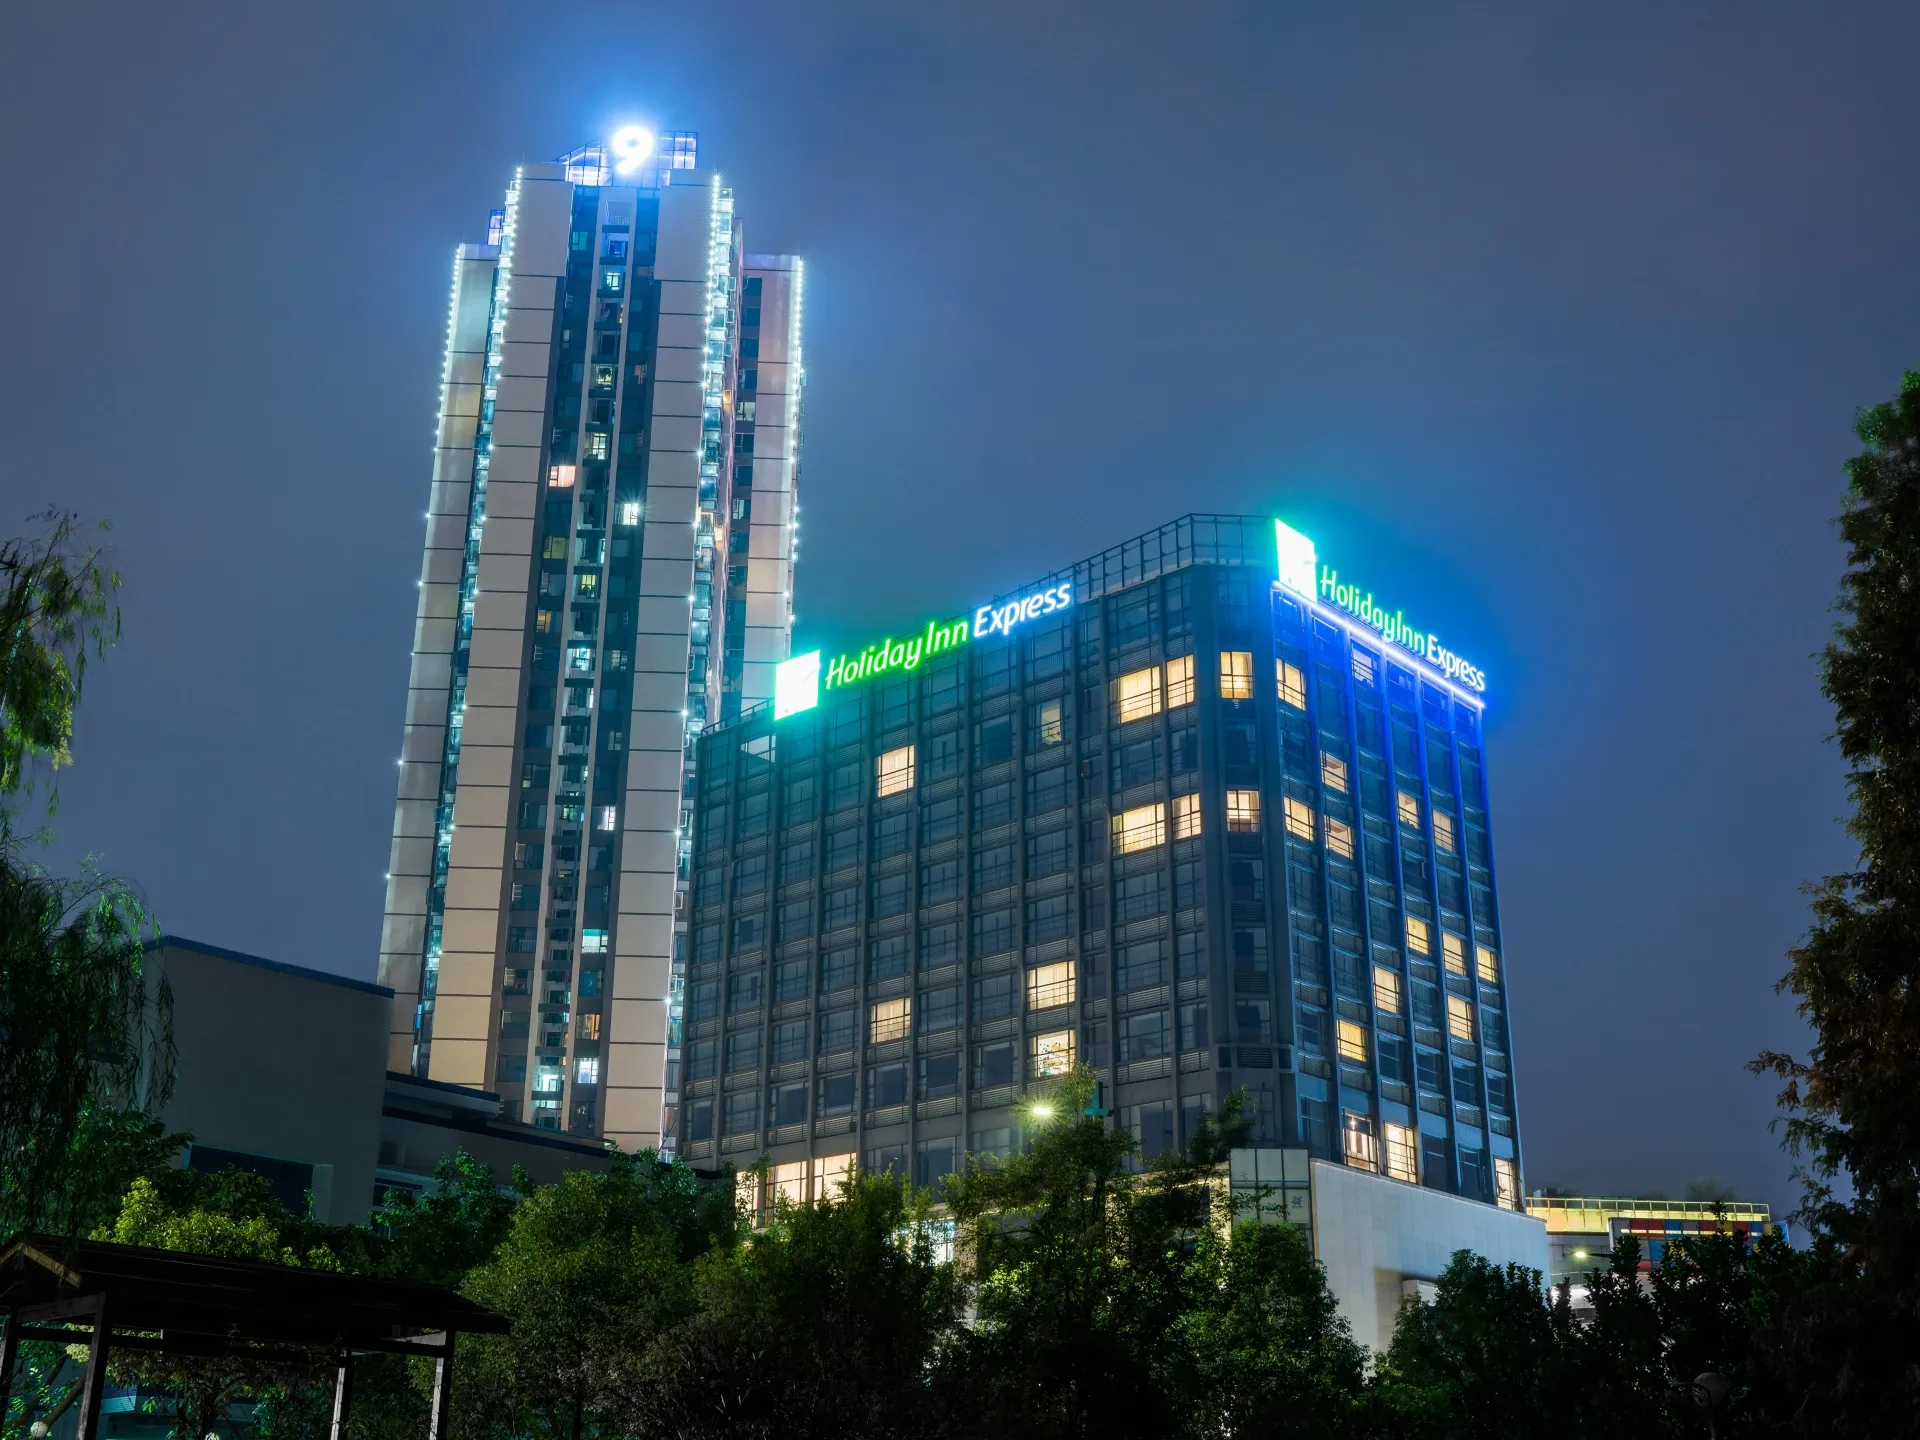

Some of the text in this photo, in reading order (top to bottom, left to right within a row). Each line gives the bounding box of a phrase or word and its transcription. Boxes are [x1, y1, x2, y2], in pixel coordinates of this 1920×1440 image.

[612, 126, 653, 175] 9
[825, 583, 1071, 690] Holiday Inn Express
[1320, 565, 1485, 692] Holiday Inn Express
